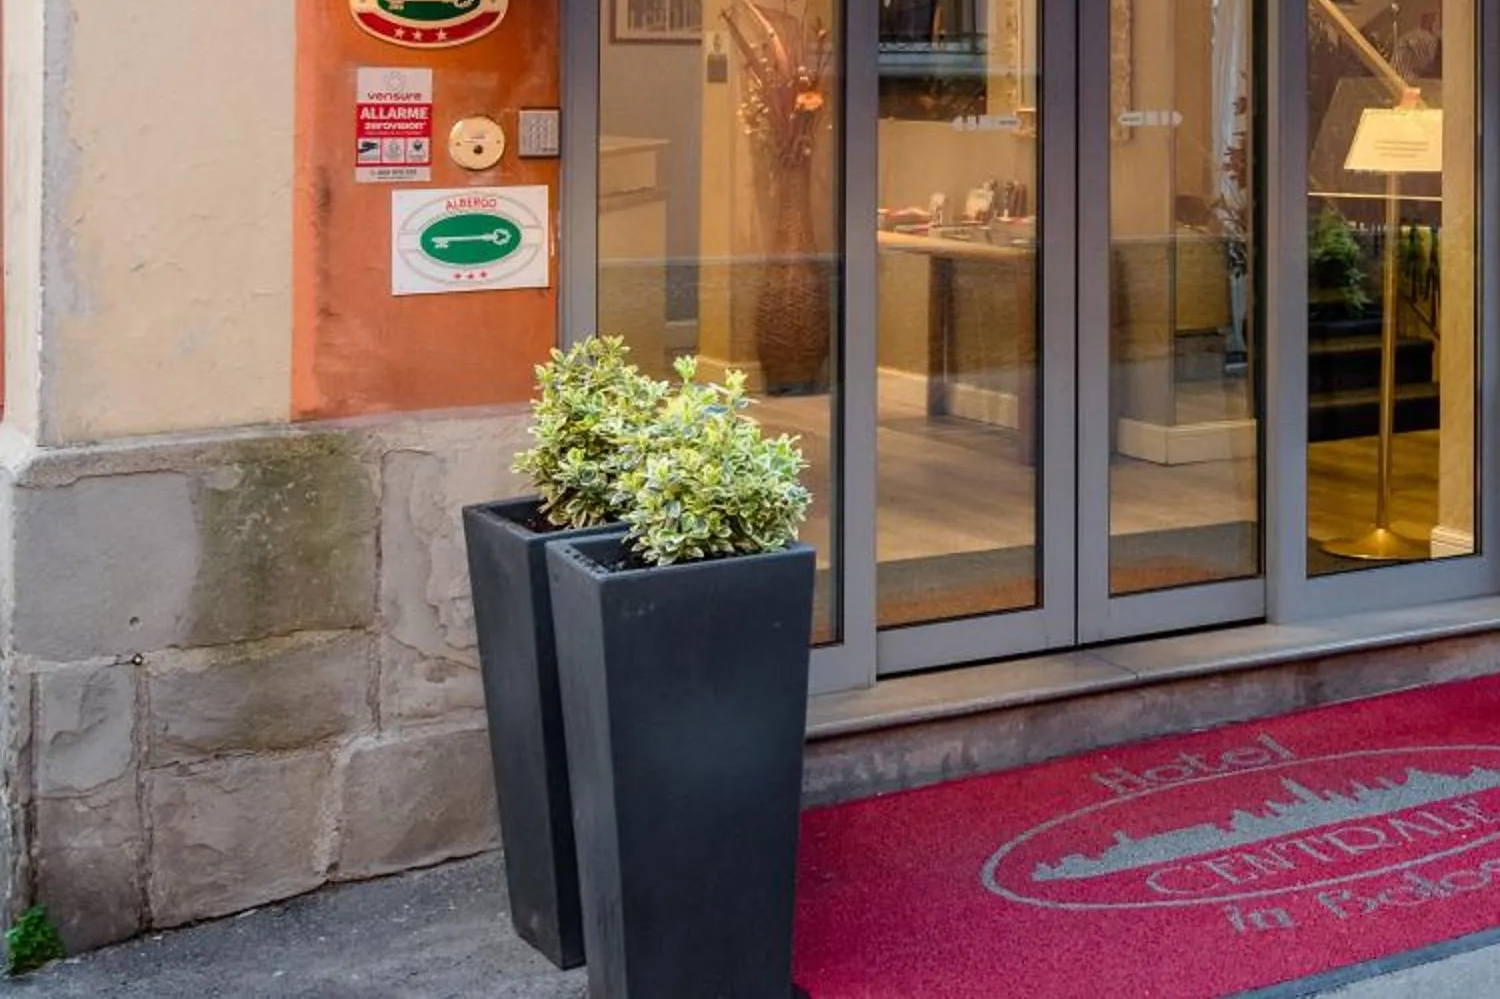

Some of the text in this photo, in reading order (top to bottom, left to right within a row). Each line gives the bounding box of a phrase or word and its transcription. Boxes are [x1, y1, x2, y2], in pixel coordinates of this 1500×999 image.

[367, 91, 423, 101] verisure
[359, 106, 430, 120] ALLARME
[445, 196, 497, 212] ALBERGO
[1089, 731, 1295, 795] Hotel
